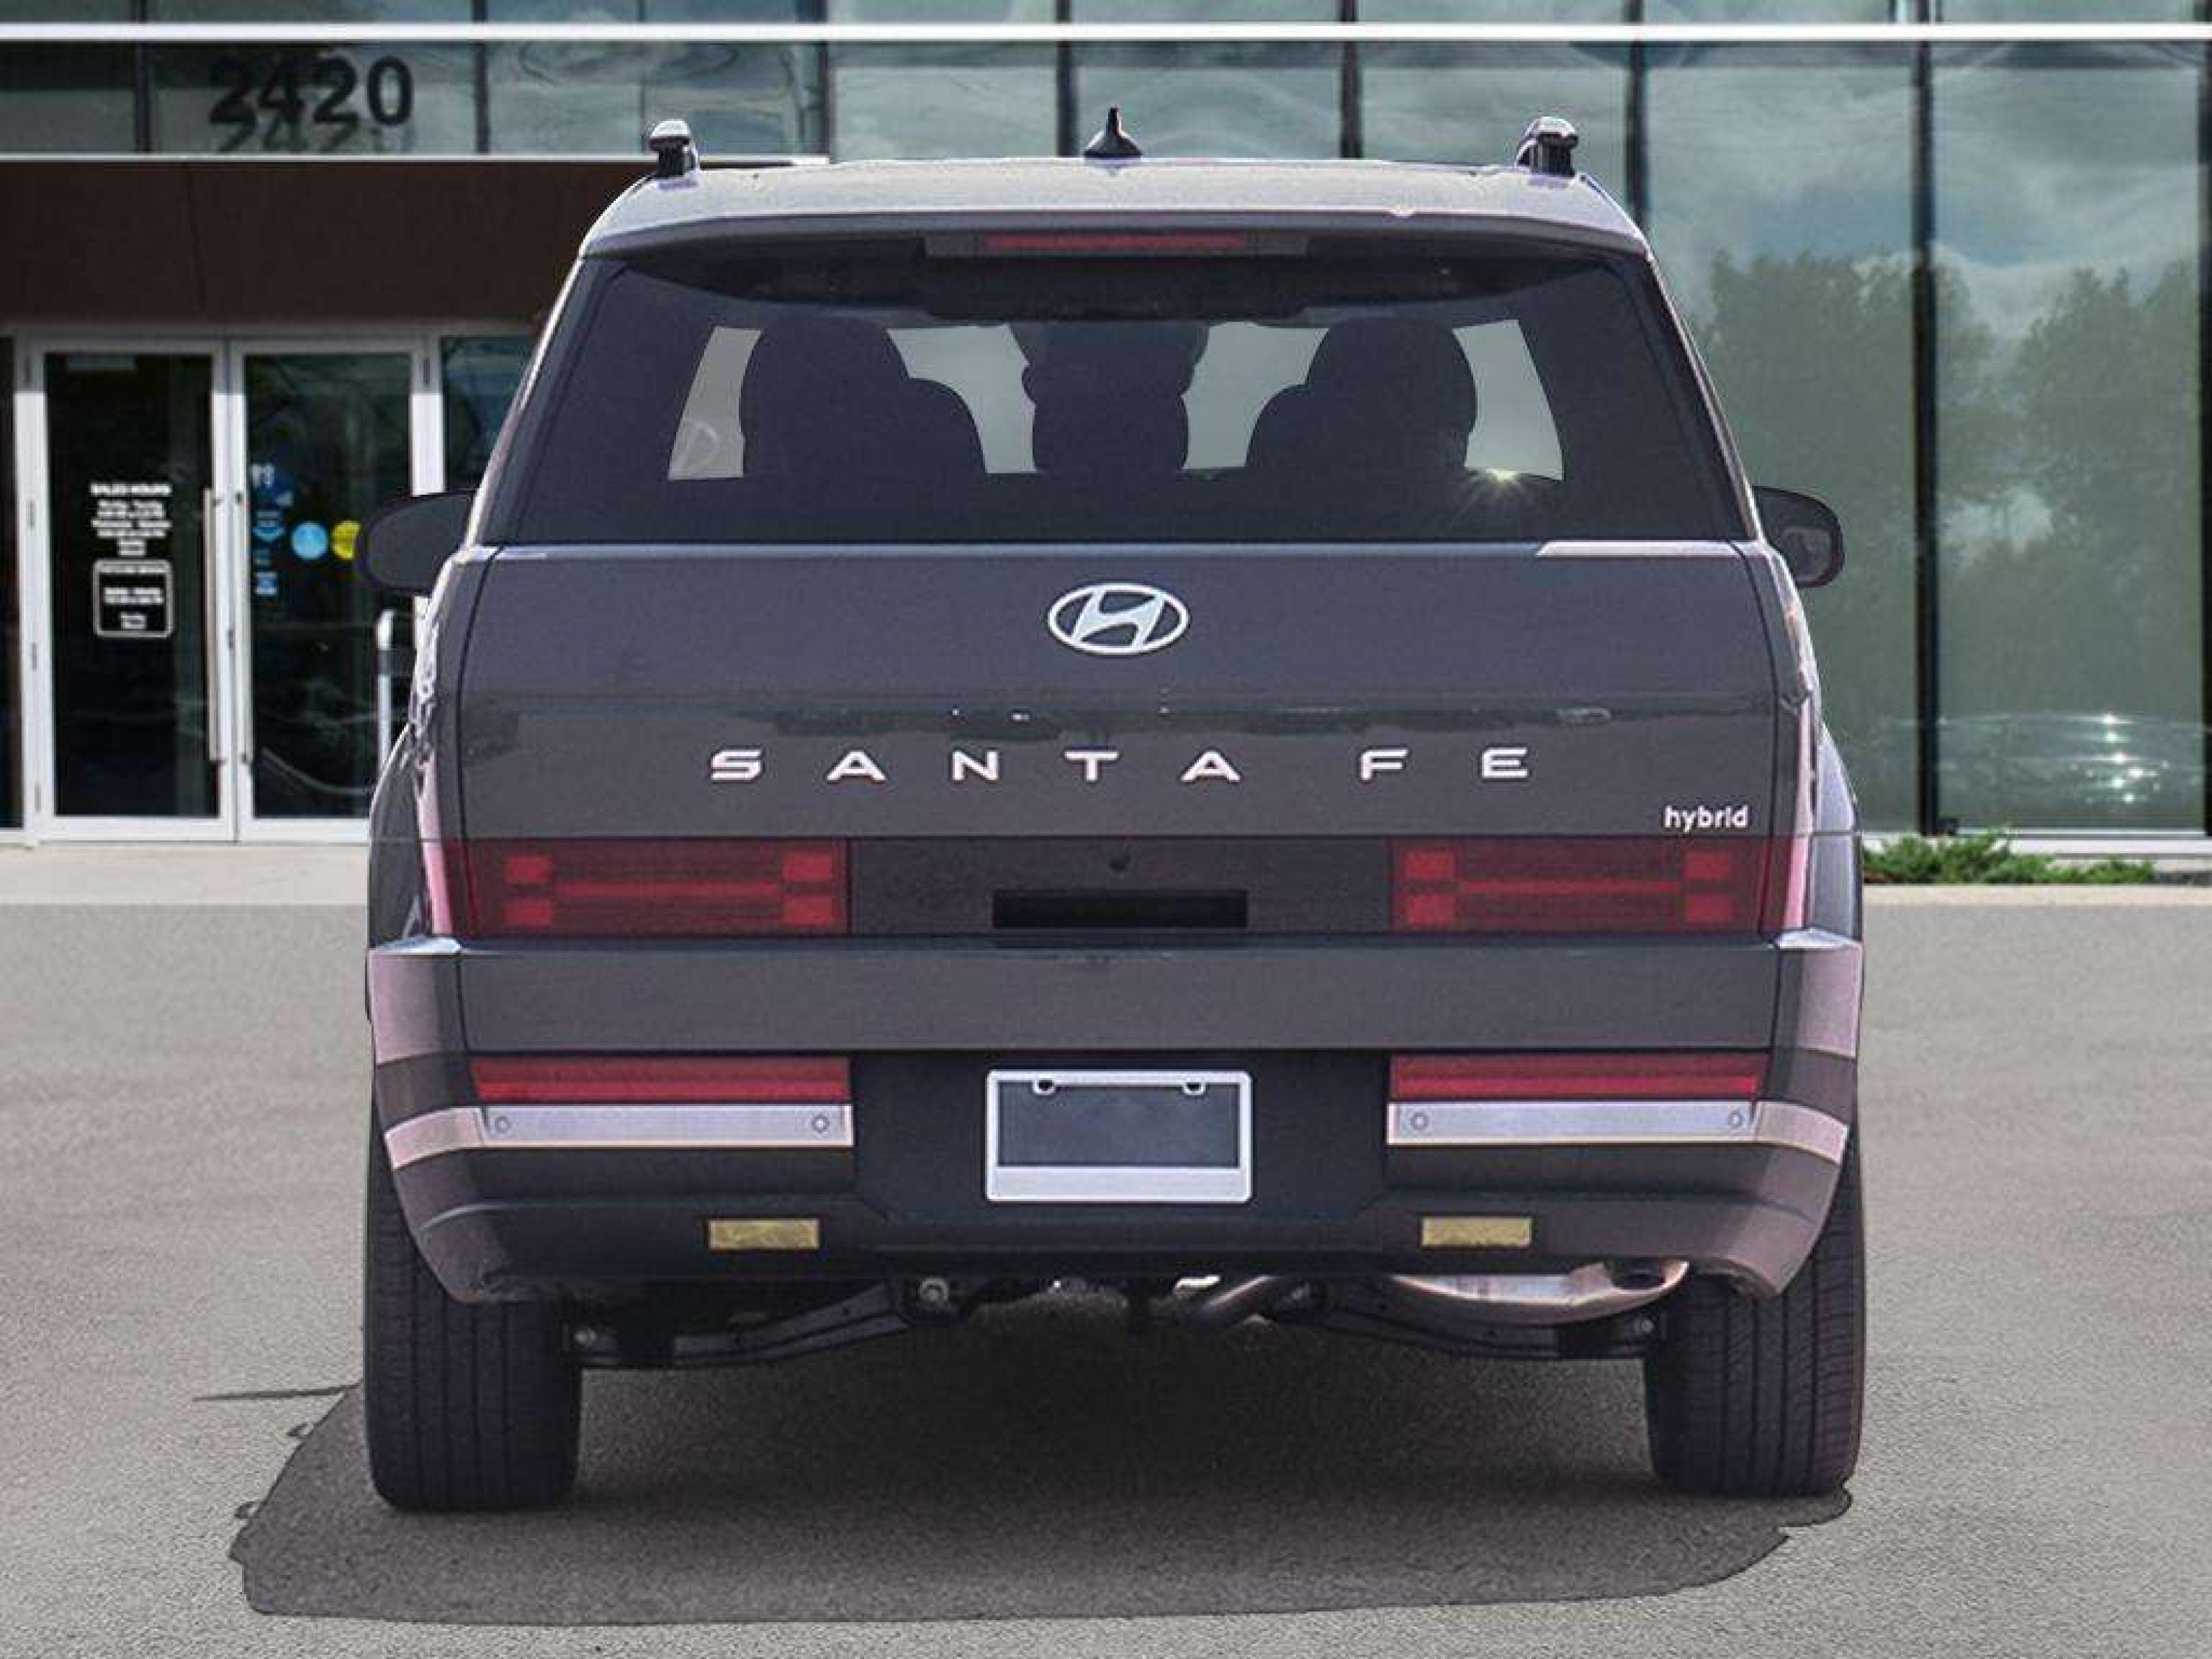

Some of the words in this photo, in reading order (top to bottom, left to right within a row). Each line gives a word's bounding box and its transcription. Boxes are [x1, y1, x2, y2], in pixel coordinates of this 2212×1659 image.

[209, 56, 414, 125] 2420
[710, 748, 1241, 782] SANTA
[1360, 747, 1528, 780] FE
[1664, 804, 1749, 834] hybrid
